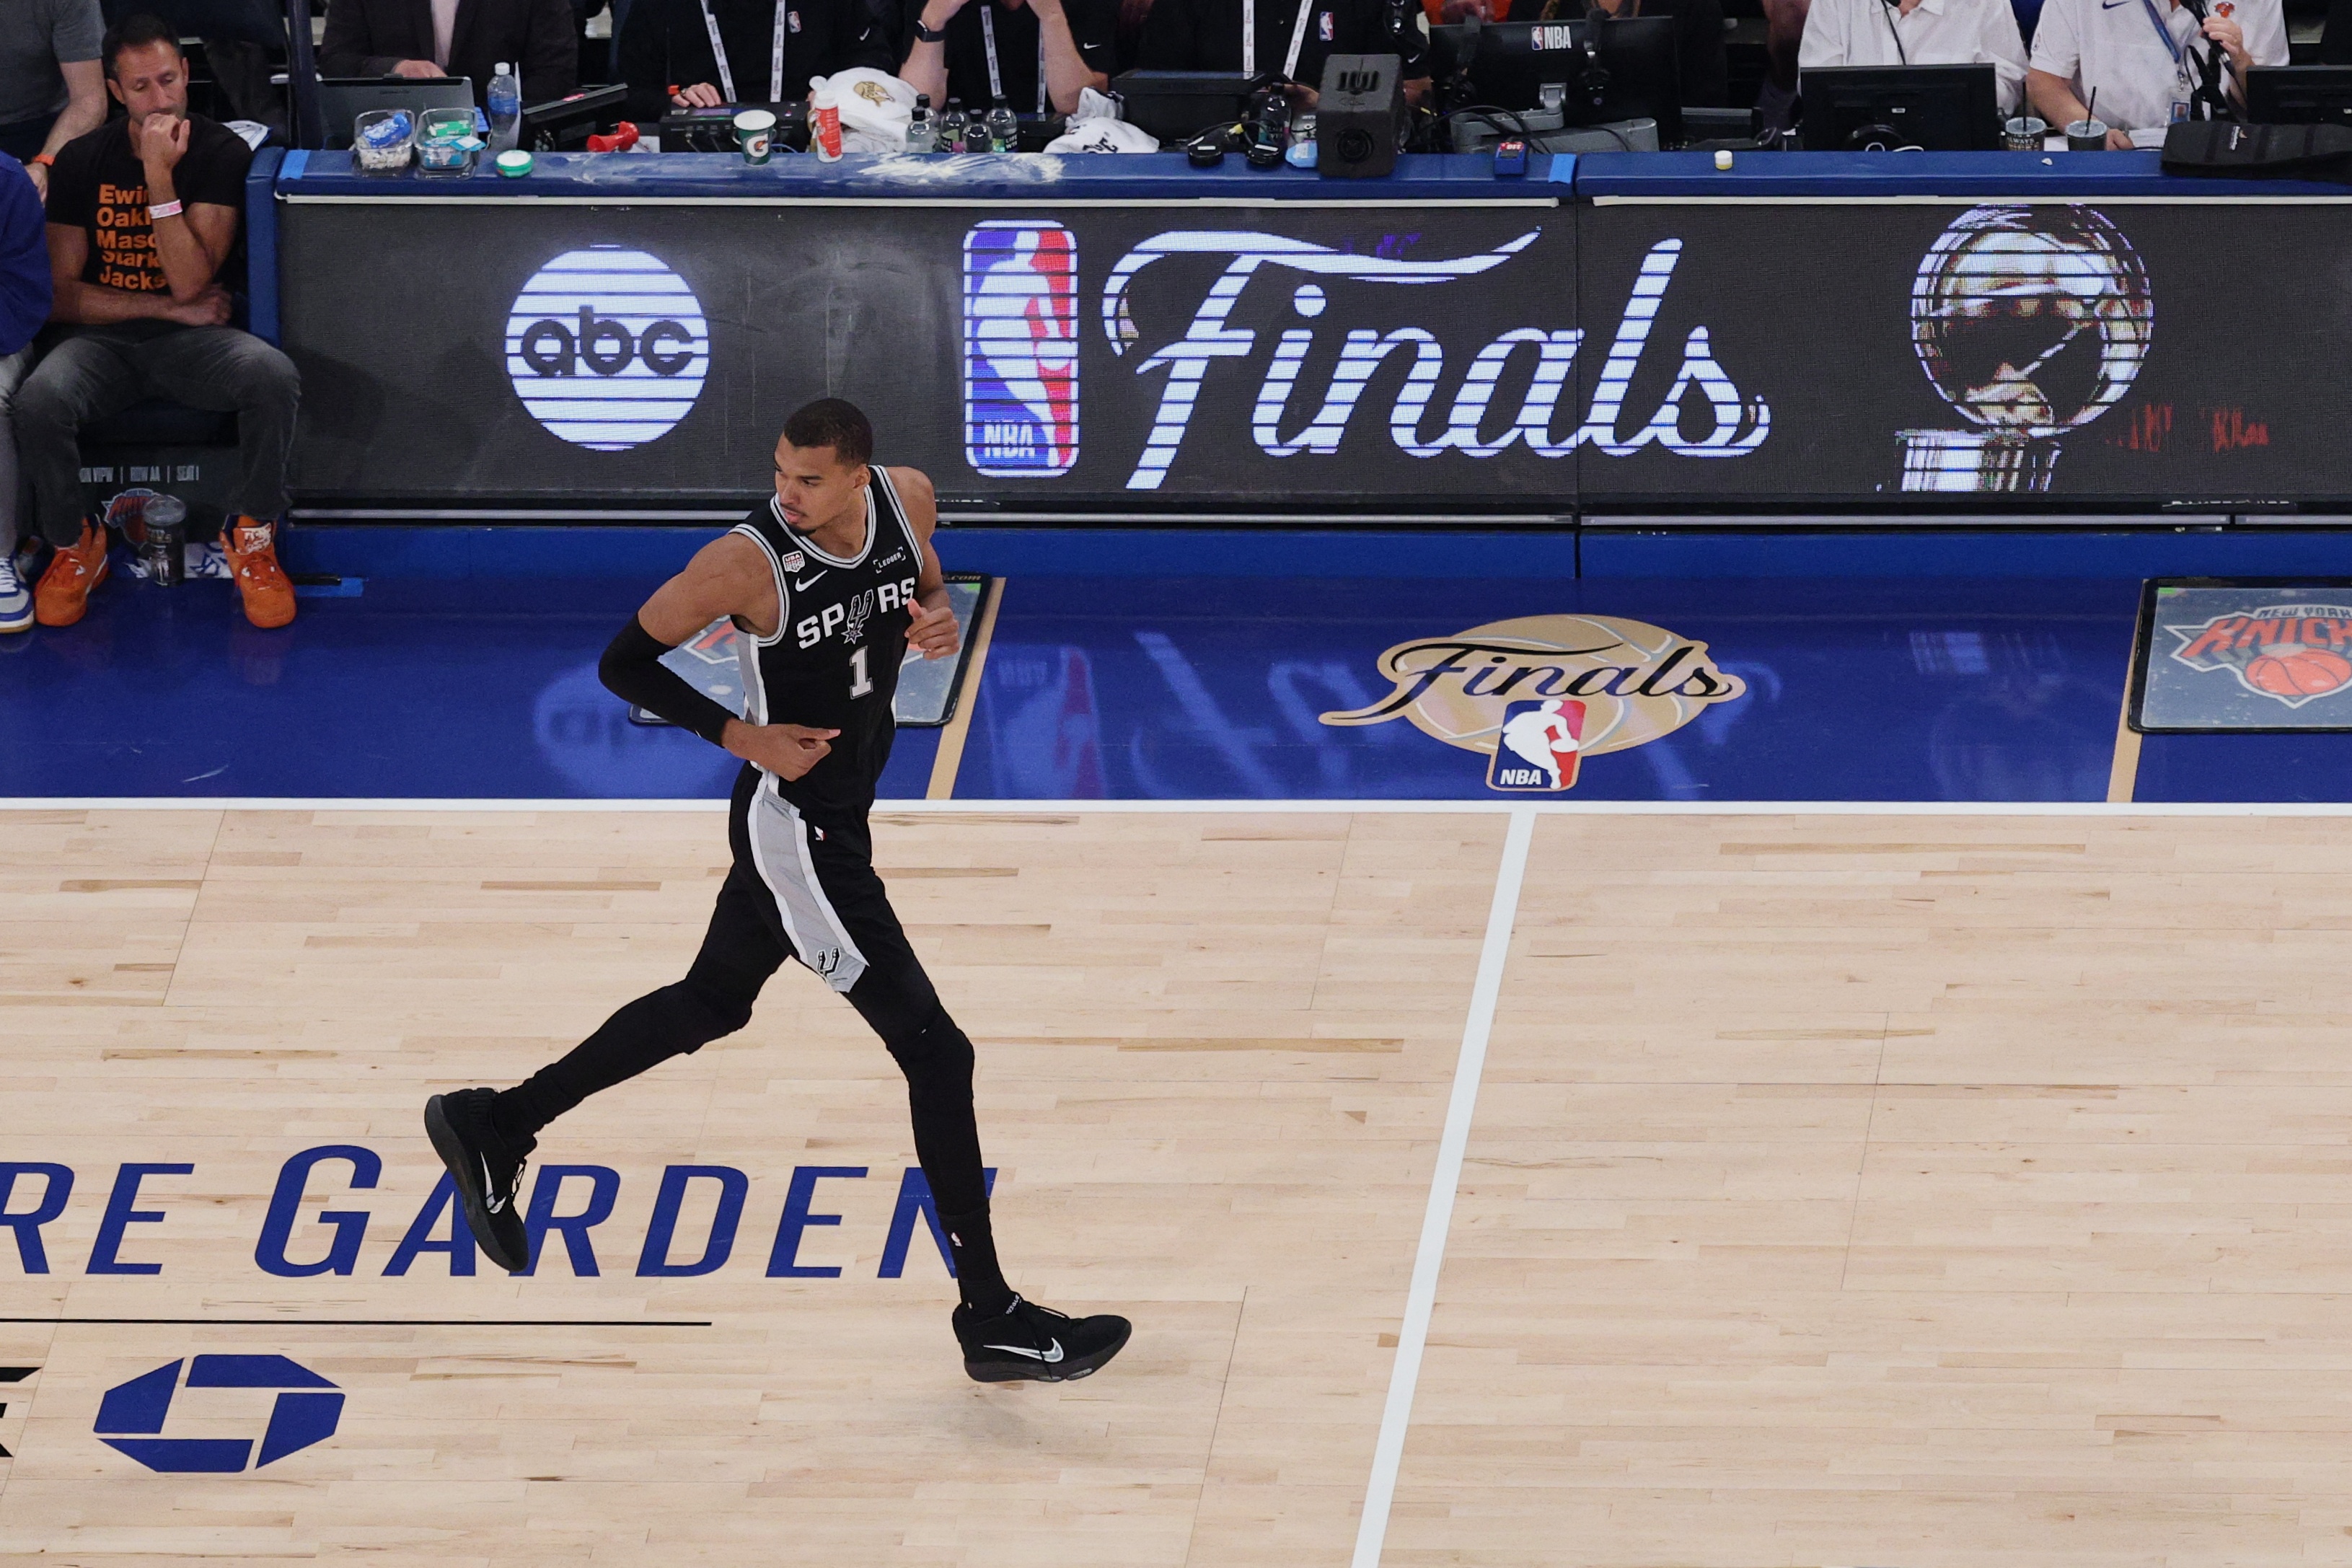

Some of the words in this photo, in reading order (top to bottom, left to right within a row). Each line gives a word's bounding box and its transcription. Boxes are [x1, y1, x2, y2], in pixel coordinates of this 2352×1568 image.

[1543, 26, 1572, 49] NBA
[522, 304, 694, 377] abc
[1103, 225, 1769, 490] Finals
[983, 420, 1035, 458] NBA
[878, 551, 902, 569] LEDGER
[796, 577, 915, 649] SPURS
[2256, 607, 2298, 618] NEW
[849, 646, 874, 700] 1
[1331, 641, 1732, 721] Finals
[1500, 769, 1541, 785] NBA
[255, 1145, 997, 1279] GARDEN
